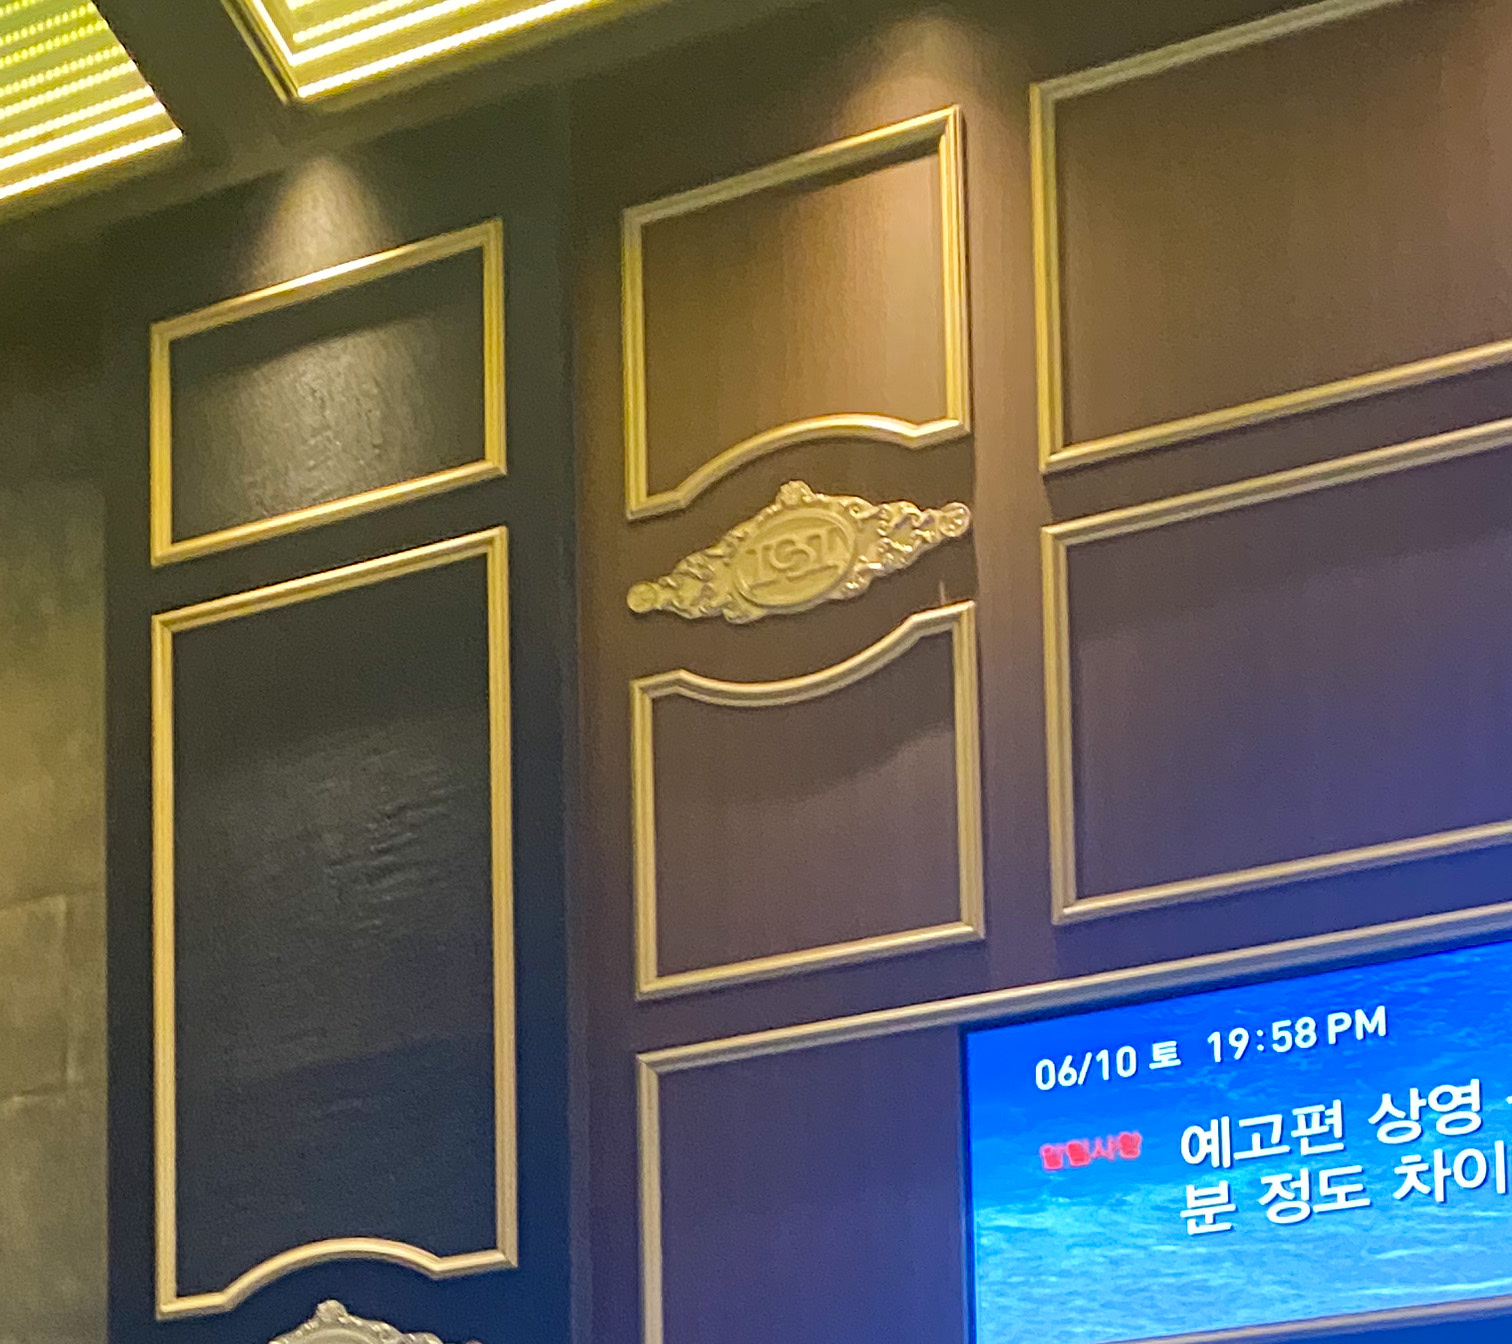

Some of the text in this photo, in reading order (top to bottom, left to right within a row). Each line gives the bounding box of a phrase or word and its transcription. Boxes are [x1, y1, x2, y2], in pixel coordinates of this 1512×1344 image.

[1034, 1004, 1388, 1091] 06/10 토 19:58 PM
[1179, 1077, 1483, 1169] 예고편 상영
[1178, 1139, 1507, 1236] 분 정도 차이
